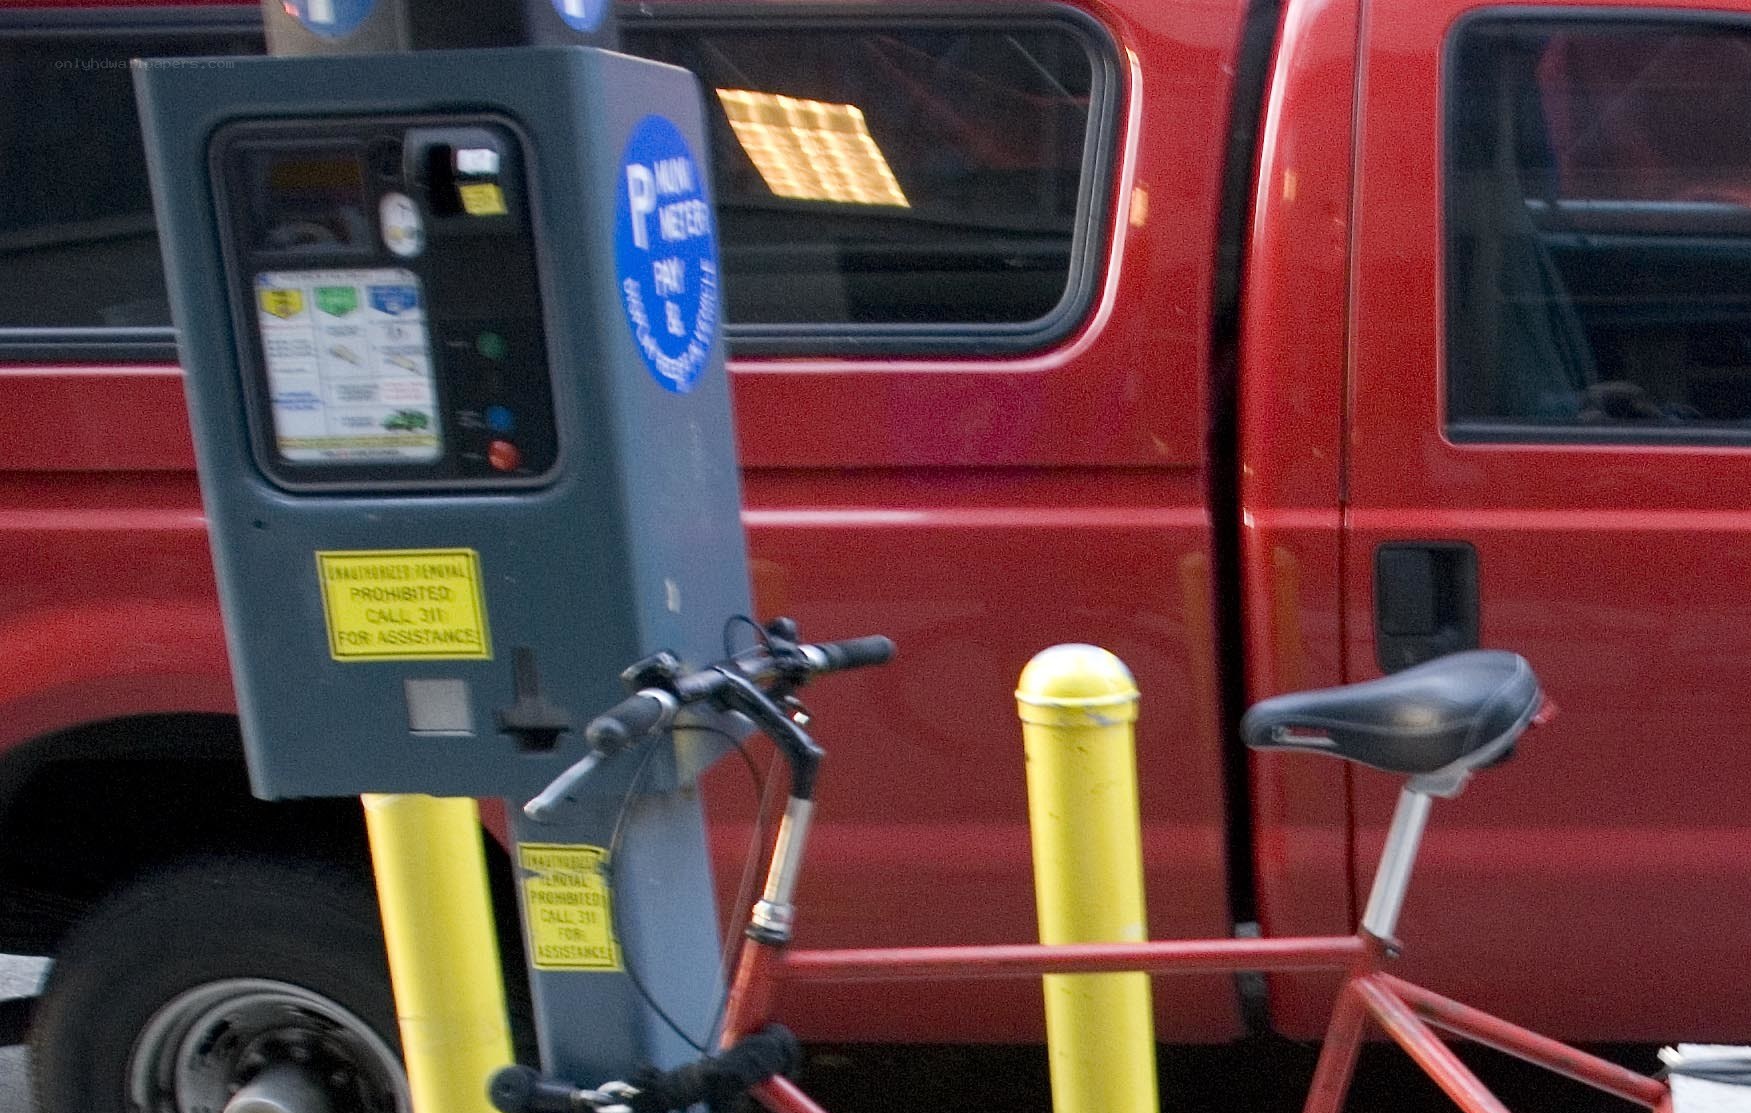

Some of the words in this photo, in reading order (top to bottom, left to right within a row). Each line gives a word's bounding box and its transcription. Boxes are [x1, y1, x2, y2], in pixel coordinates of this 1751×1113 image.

[626, 163, 657, 250] P
[328, 564, 409, 581] UNAUTHORIZED
[415, 563, 467, 580] REMOVAL
[351, 585, 451, 601] PROHIBITED
[365, 608, 415, 625] CALL
[419, 607, 444, 623] 311
[338, 630, 370, 646] FOR
[378, 628, 479, 645] ASSISTANCE
[529, 890, 600, 906] PROHIBITED
[541, 908, 575, 924] CALL
[577, 909, 597, 924] 311
[538, 944, 607, 959] ASSISTANCE
